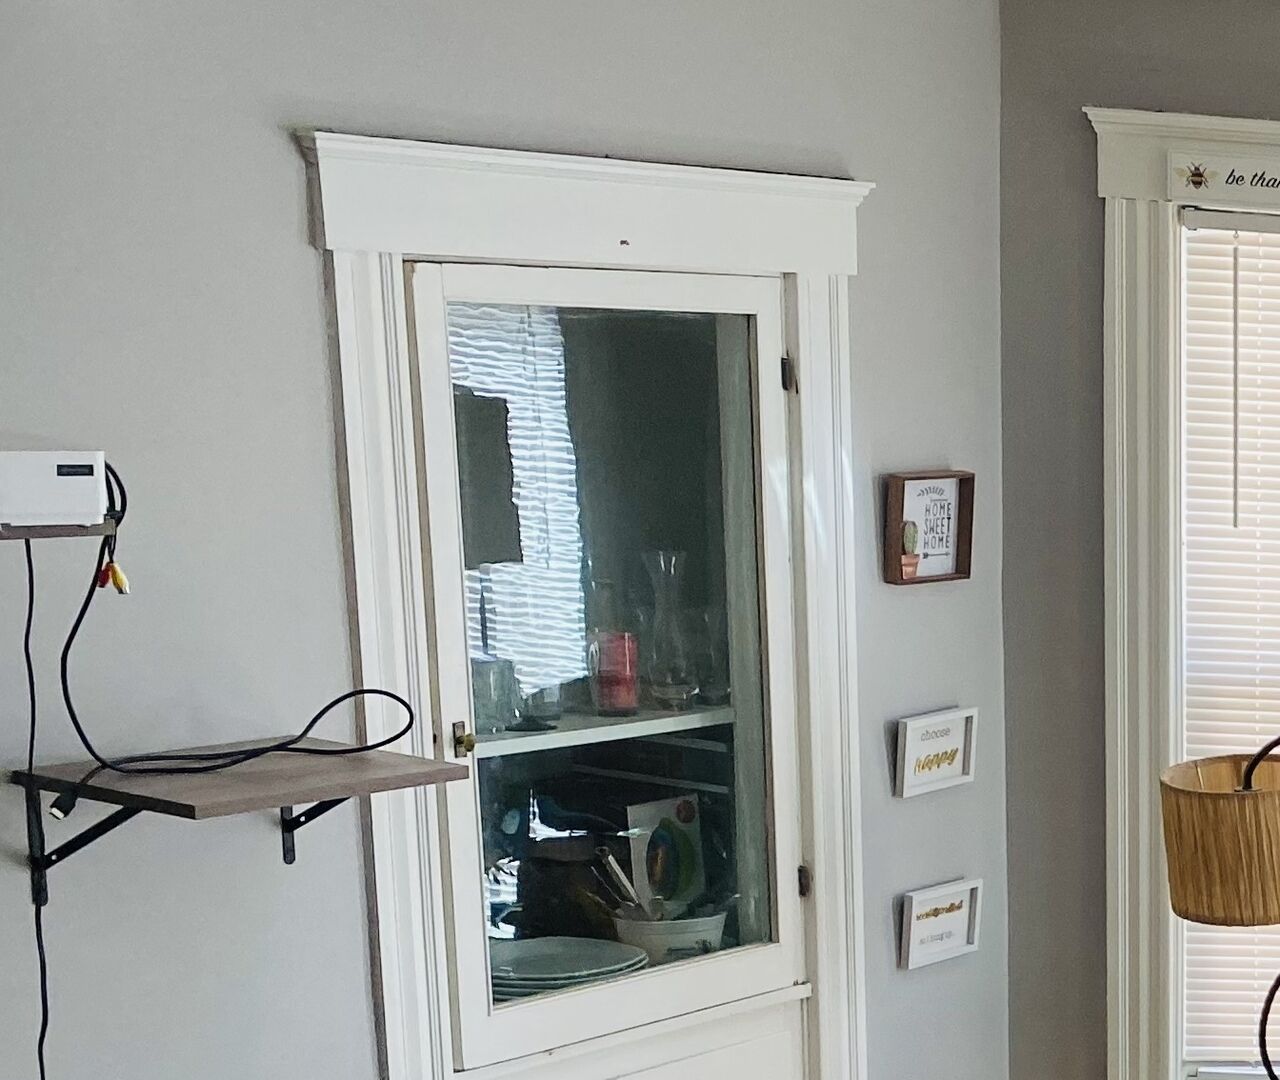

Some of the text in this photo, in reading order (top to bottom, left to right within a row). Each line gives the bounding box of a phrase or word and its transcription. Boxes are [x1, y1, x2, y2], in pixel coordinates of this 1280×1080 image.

[1225, 168, 1246, 186] be
[924, 502, 952, 517] HOME
[923, 517, 952, 536] SWEET
[923, 535, 951, 549] HOME
